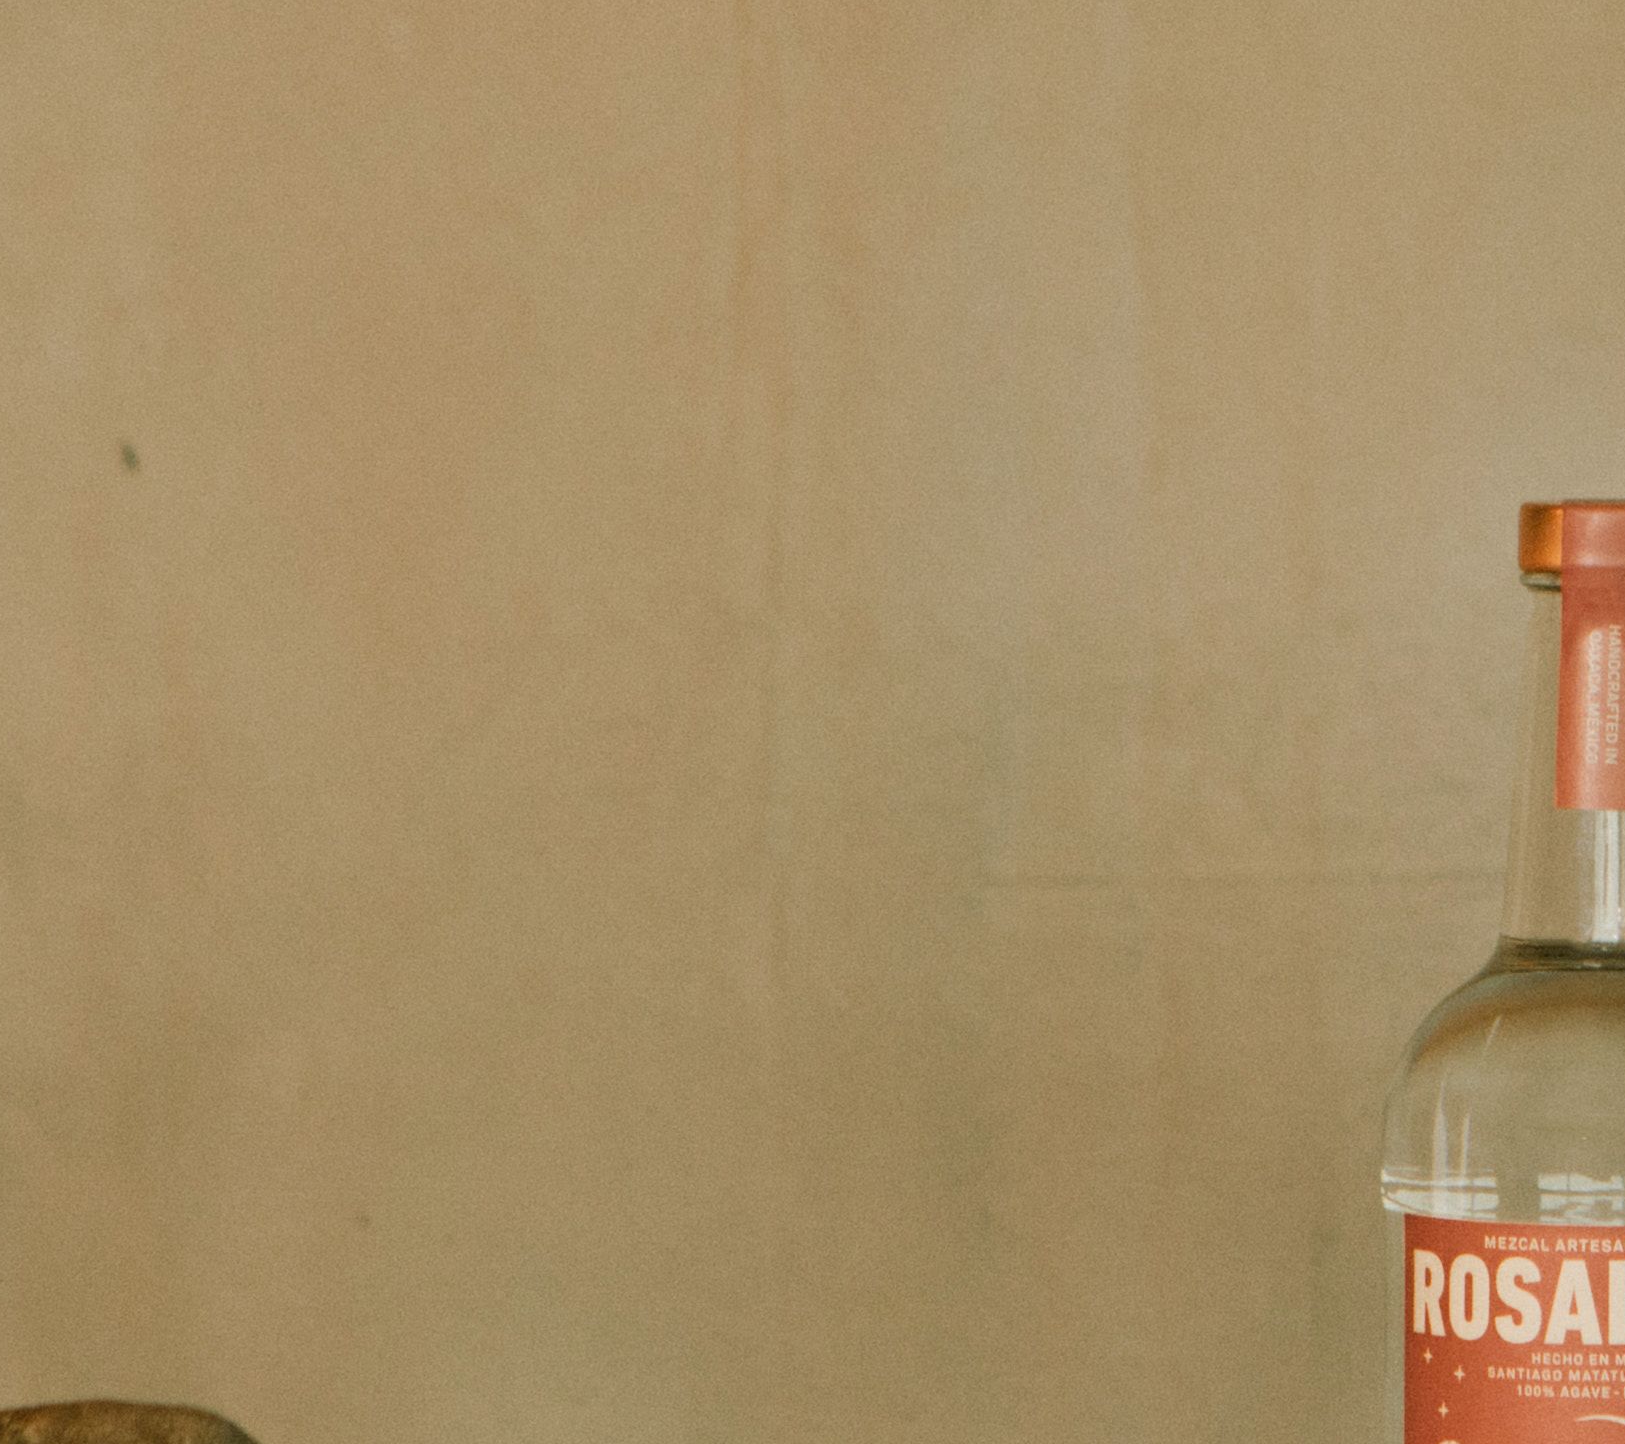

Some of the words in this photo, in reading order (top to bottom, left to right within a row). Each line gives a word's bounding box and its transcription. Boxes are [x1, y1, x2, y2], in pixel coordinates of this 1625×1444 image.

[1606, 624, 1622, 743] HANDCRAFTED
[1605, 747, 1619, 765] IN
[1484, 1236, 1549, 1252] MEZCAL
[1532, 1353, 1583, 1366] HECHO
[1589, 1353, 1609, 1366] EN
[1488, 1367, 1562, 1381] SANTIAGO
[1517, 1385, 1554, 1398] 100%
[1560, 1385, 1609, 1398] AGAVE
